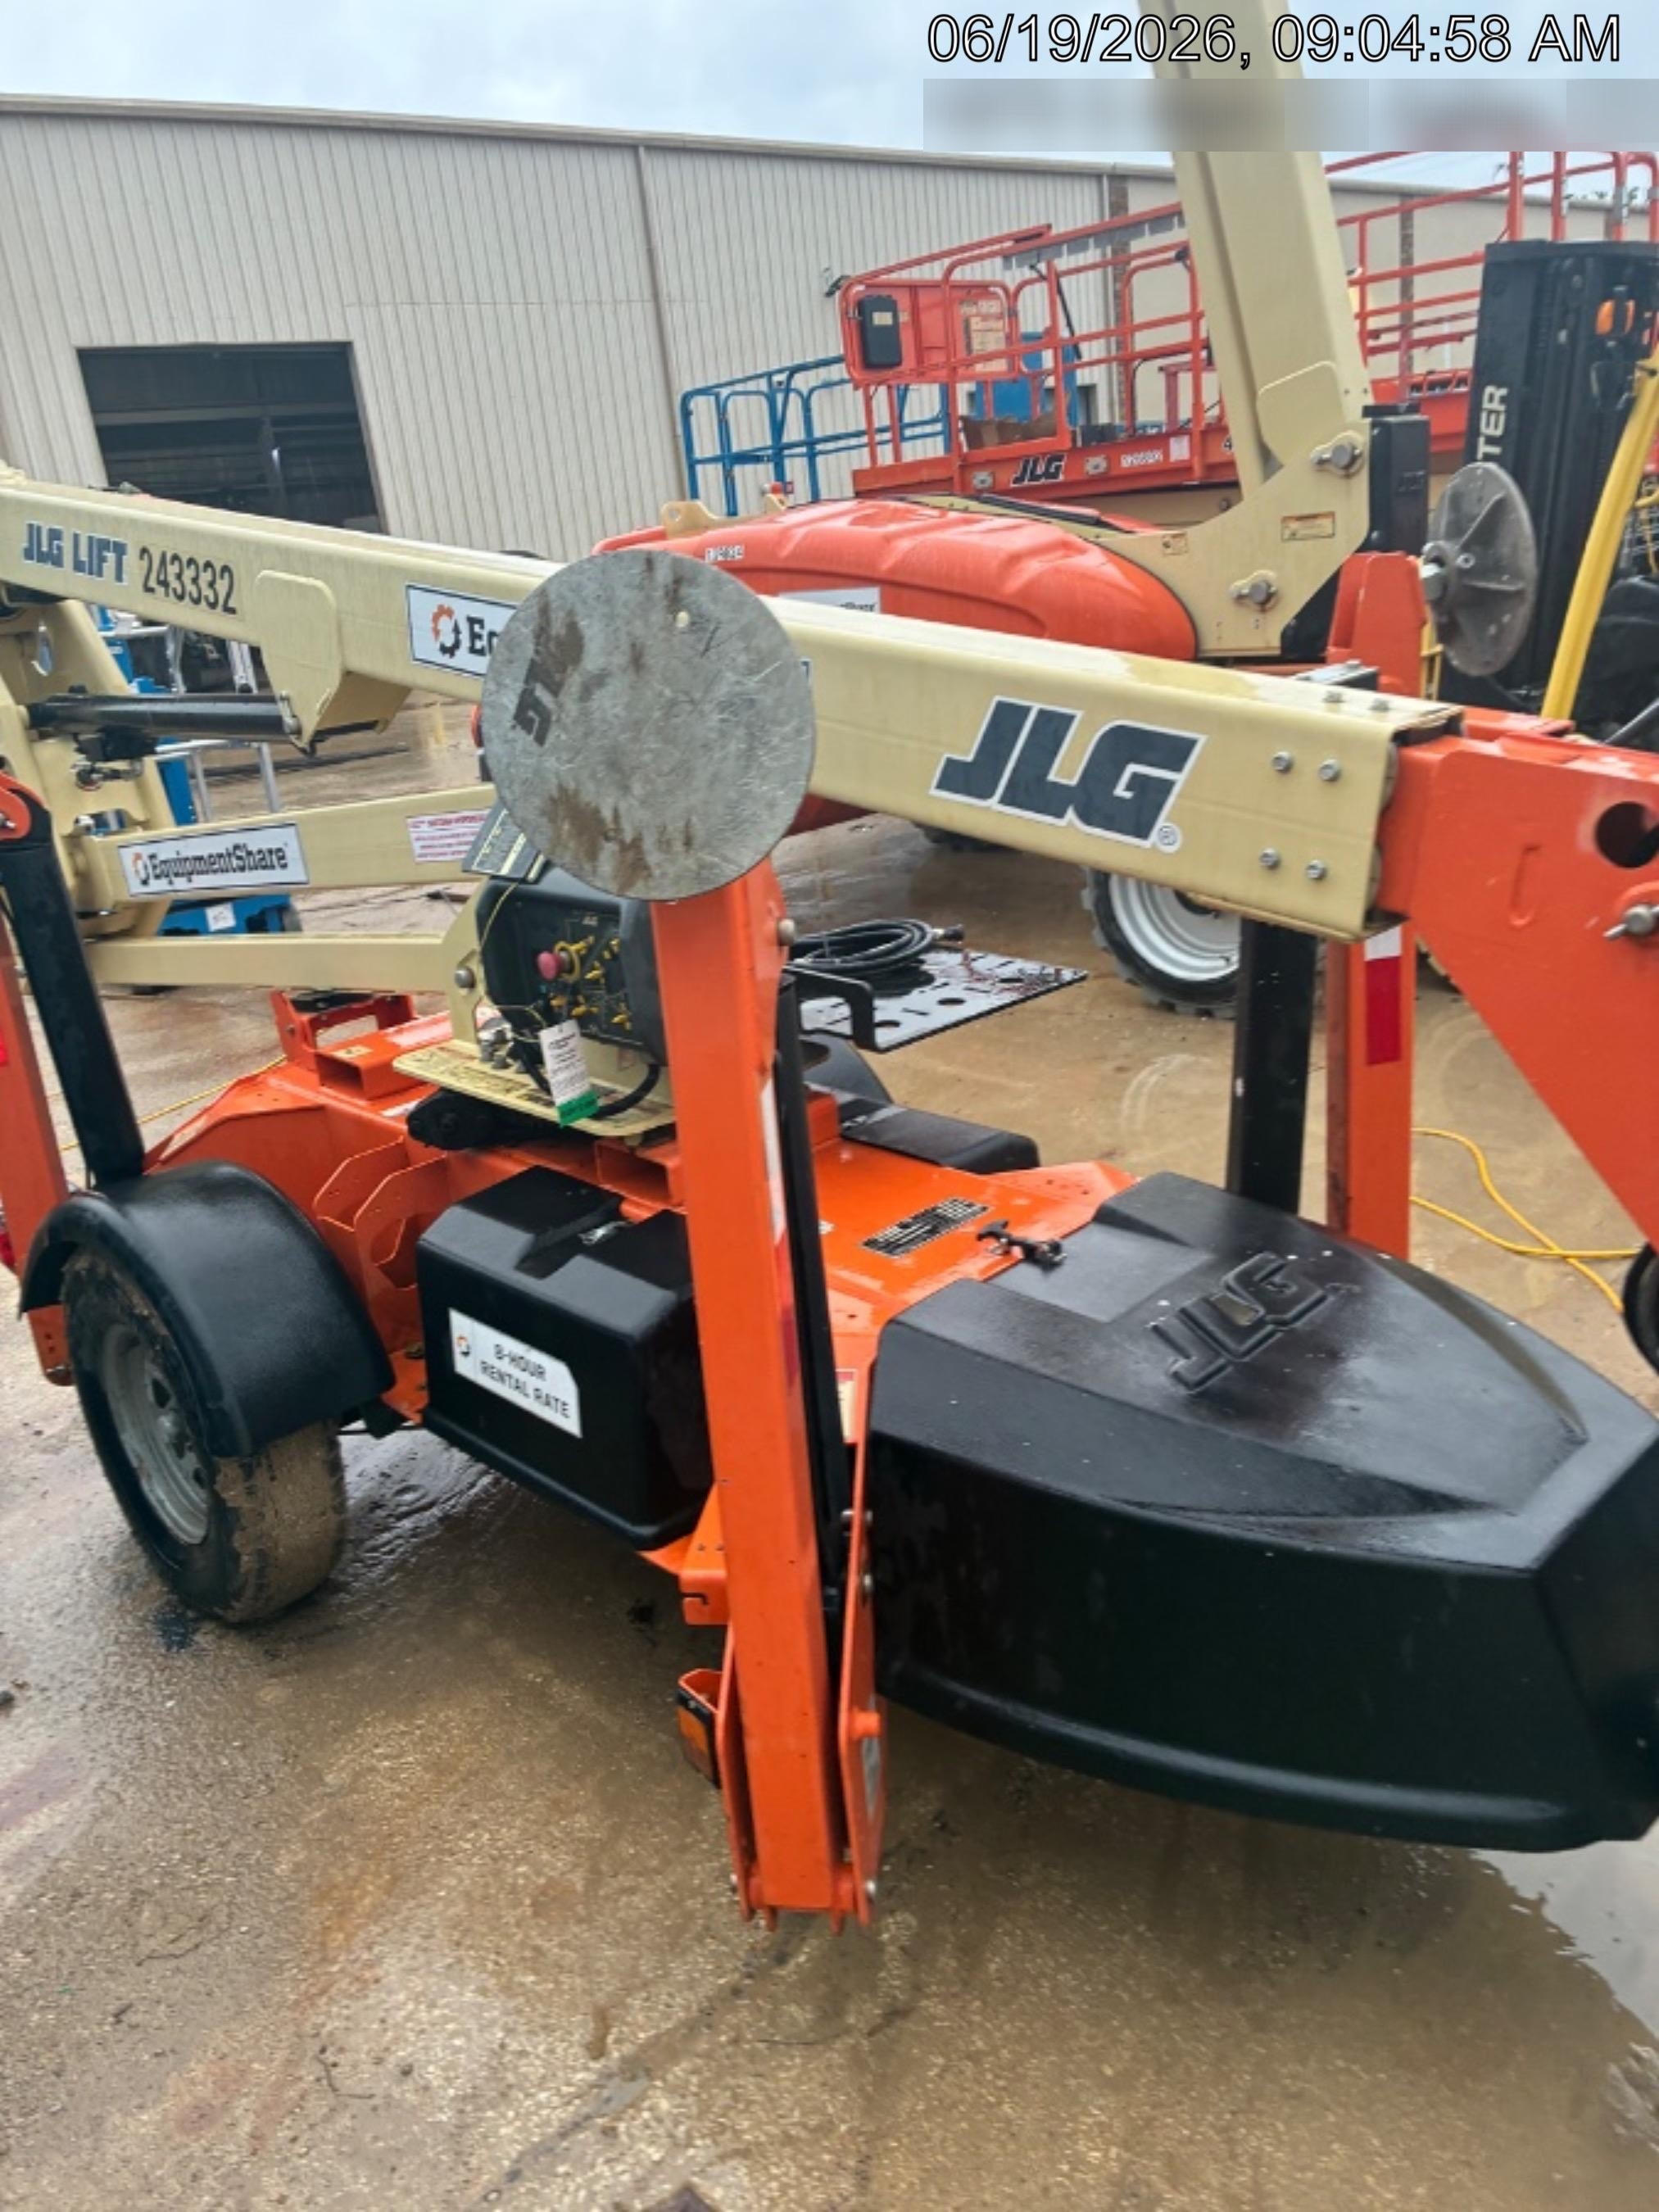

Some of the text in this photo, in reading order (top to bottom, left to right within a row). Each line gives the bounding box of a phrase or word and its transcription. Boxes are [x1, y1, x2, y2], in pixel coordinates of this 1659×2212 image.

[1011, 454, 1064, 486] JLG
[23, 522, 128, 584] JLG LIFT
[139, 546, 237, 614] 243332
[931, 696, 1204, 845] JLG
[147, 842, 288, 886] EquipmentShare
[1145, 1251, 1329, 1394] JLG
[480, 1360, 570, 1419] RENTAL RATE
[493, 1344, 546, 1381] 8-HOUR
